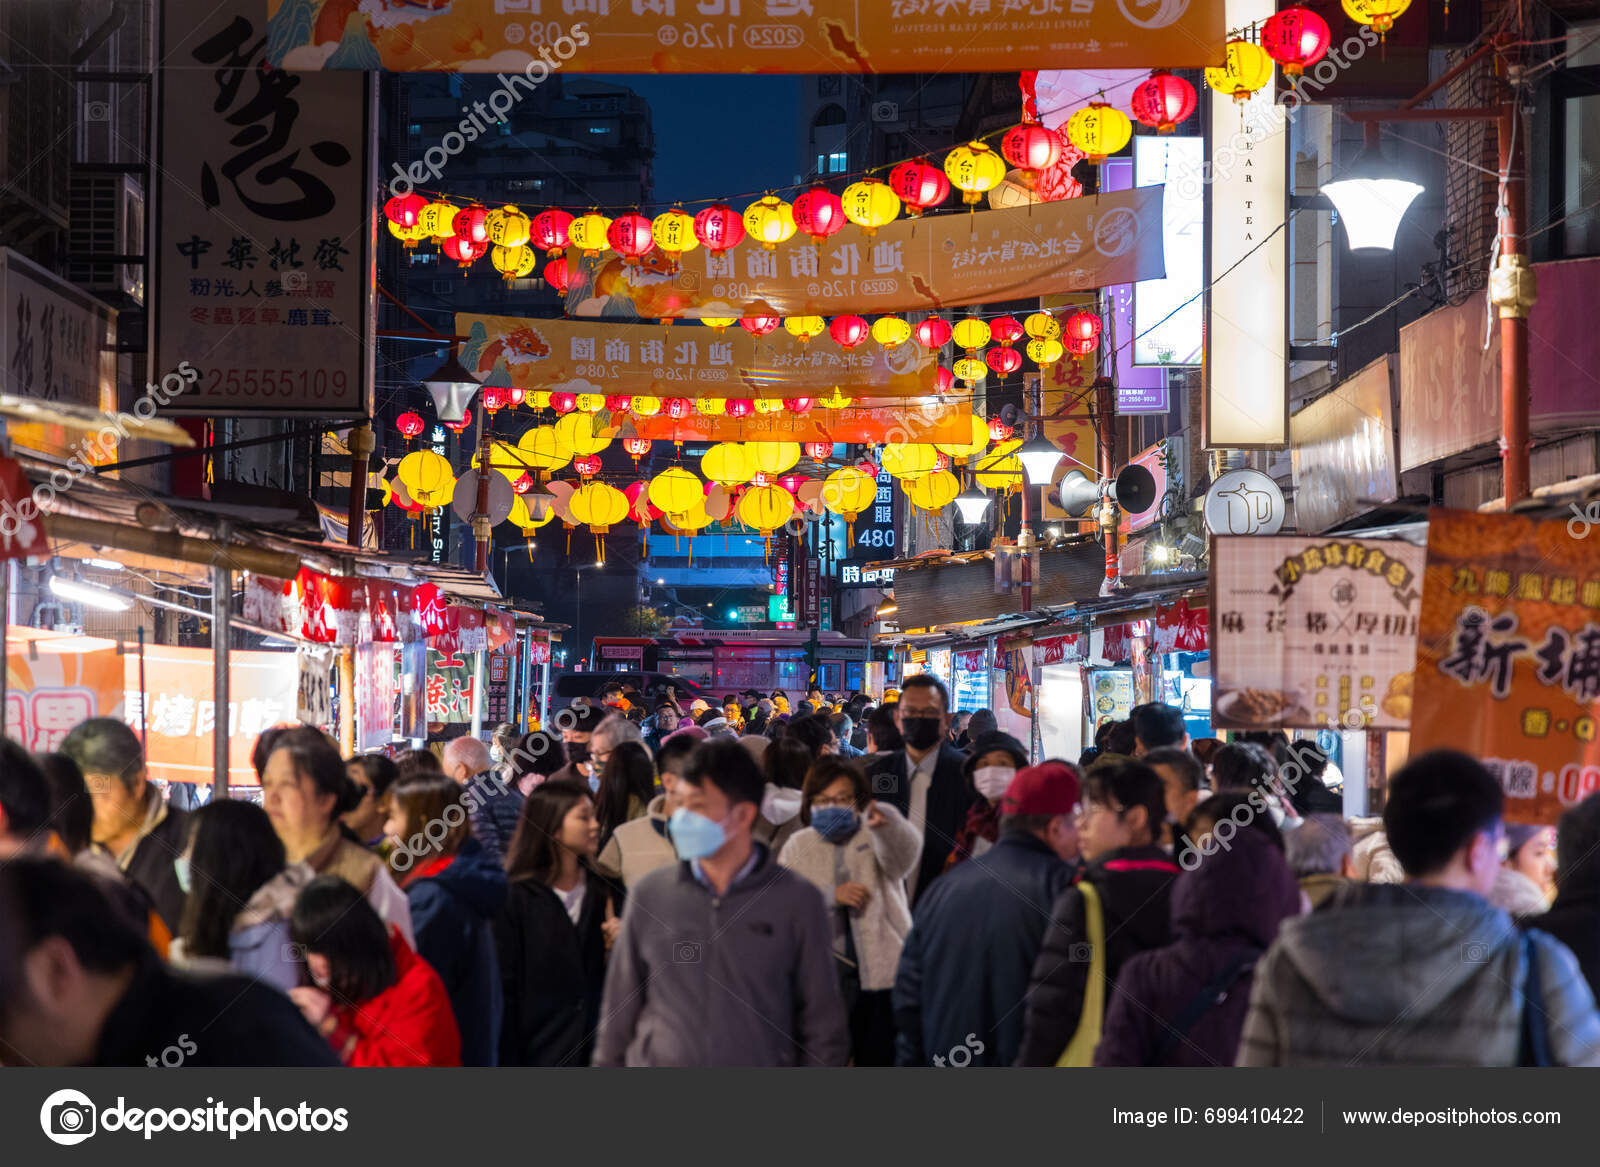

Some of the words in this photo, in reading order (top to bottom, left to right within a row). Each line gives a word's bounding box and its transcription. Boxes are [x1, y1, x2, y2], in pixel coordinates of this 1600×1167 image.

[1281, 13, 1297, 47] 台北
[1145, 83, 1162, 114] 台北
[1085, 115, 1097, 144] 台北
[1245, 126, 1253, 183] DEAR
[904, 169, 917, 196] 台北
[856, 191, 868, 217] 台北
[426, 209, 437, 231] 台北
[459, 214, 470, 237] 台北
[493, 221, 503, 241] 台北
[620, 221, 631, 246] 台北
[668, 220, 680, 245] 台北
[711, 215, 723, 242] 台北
[1245, 200, 1253, 241] TEA
[176, 235, 350, 272] 中藥批發
[208, 368, 347, 398] 25555109
[859, 529, 894, 547] 480
